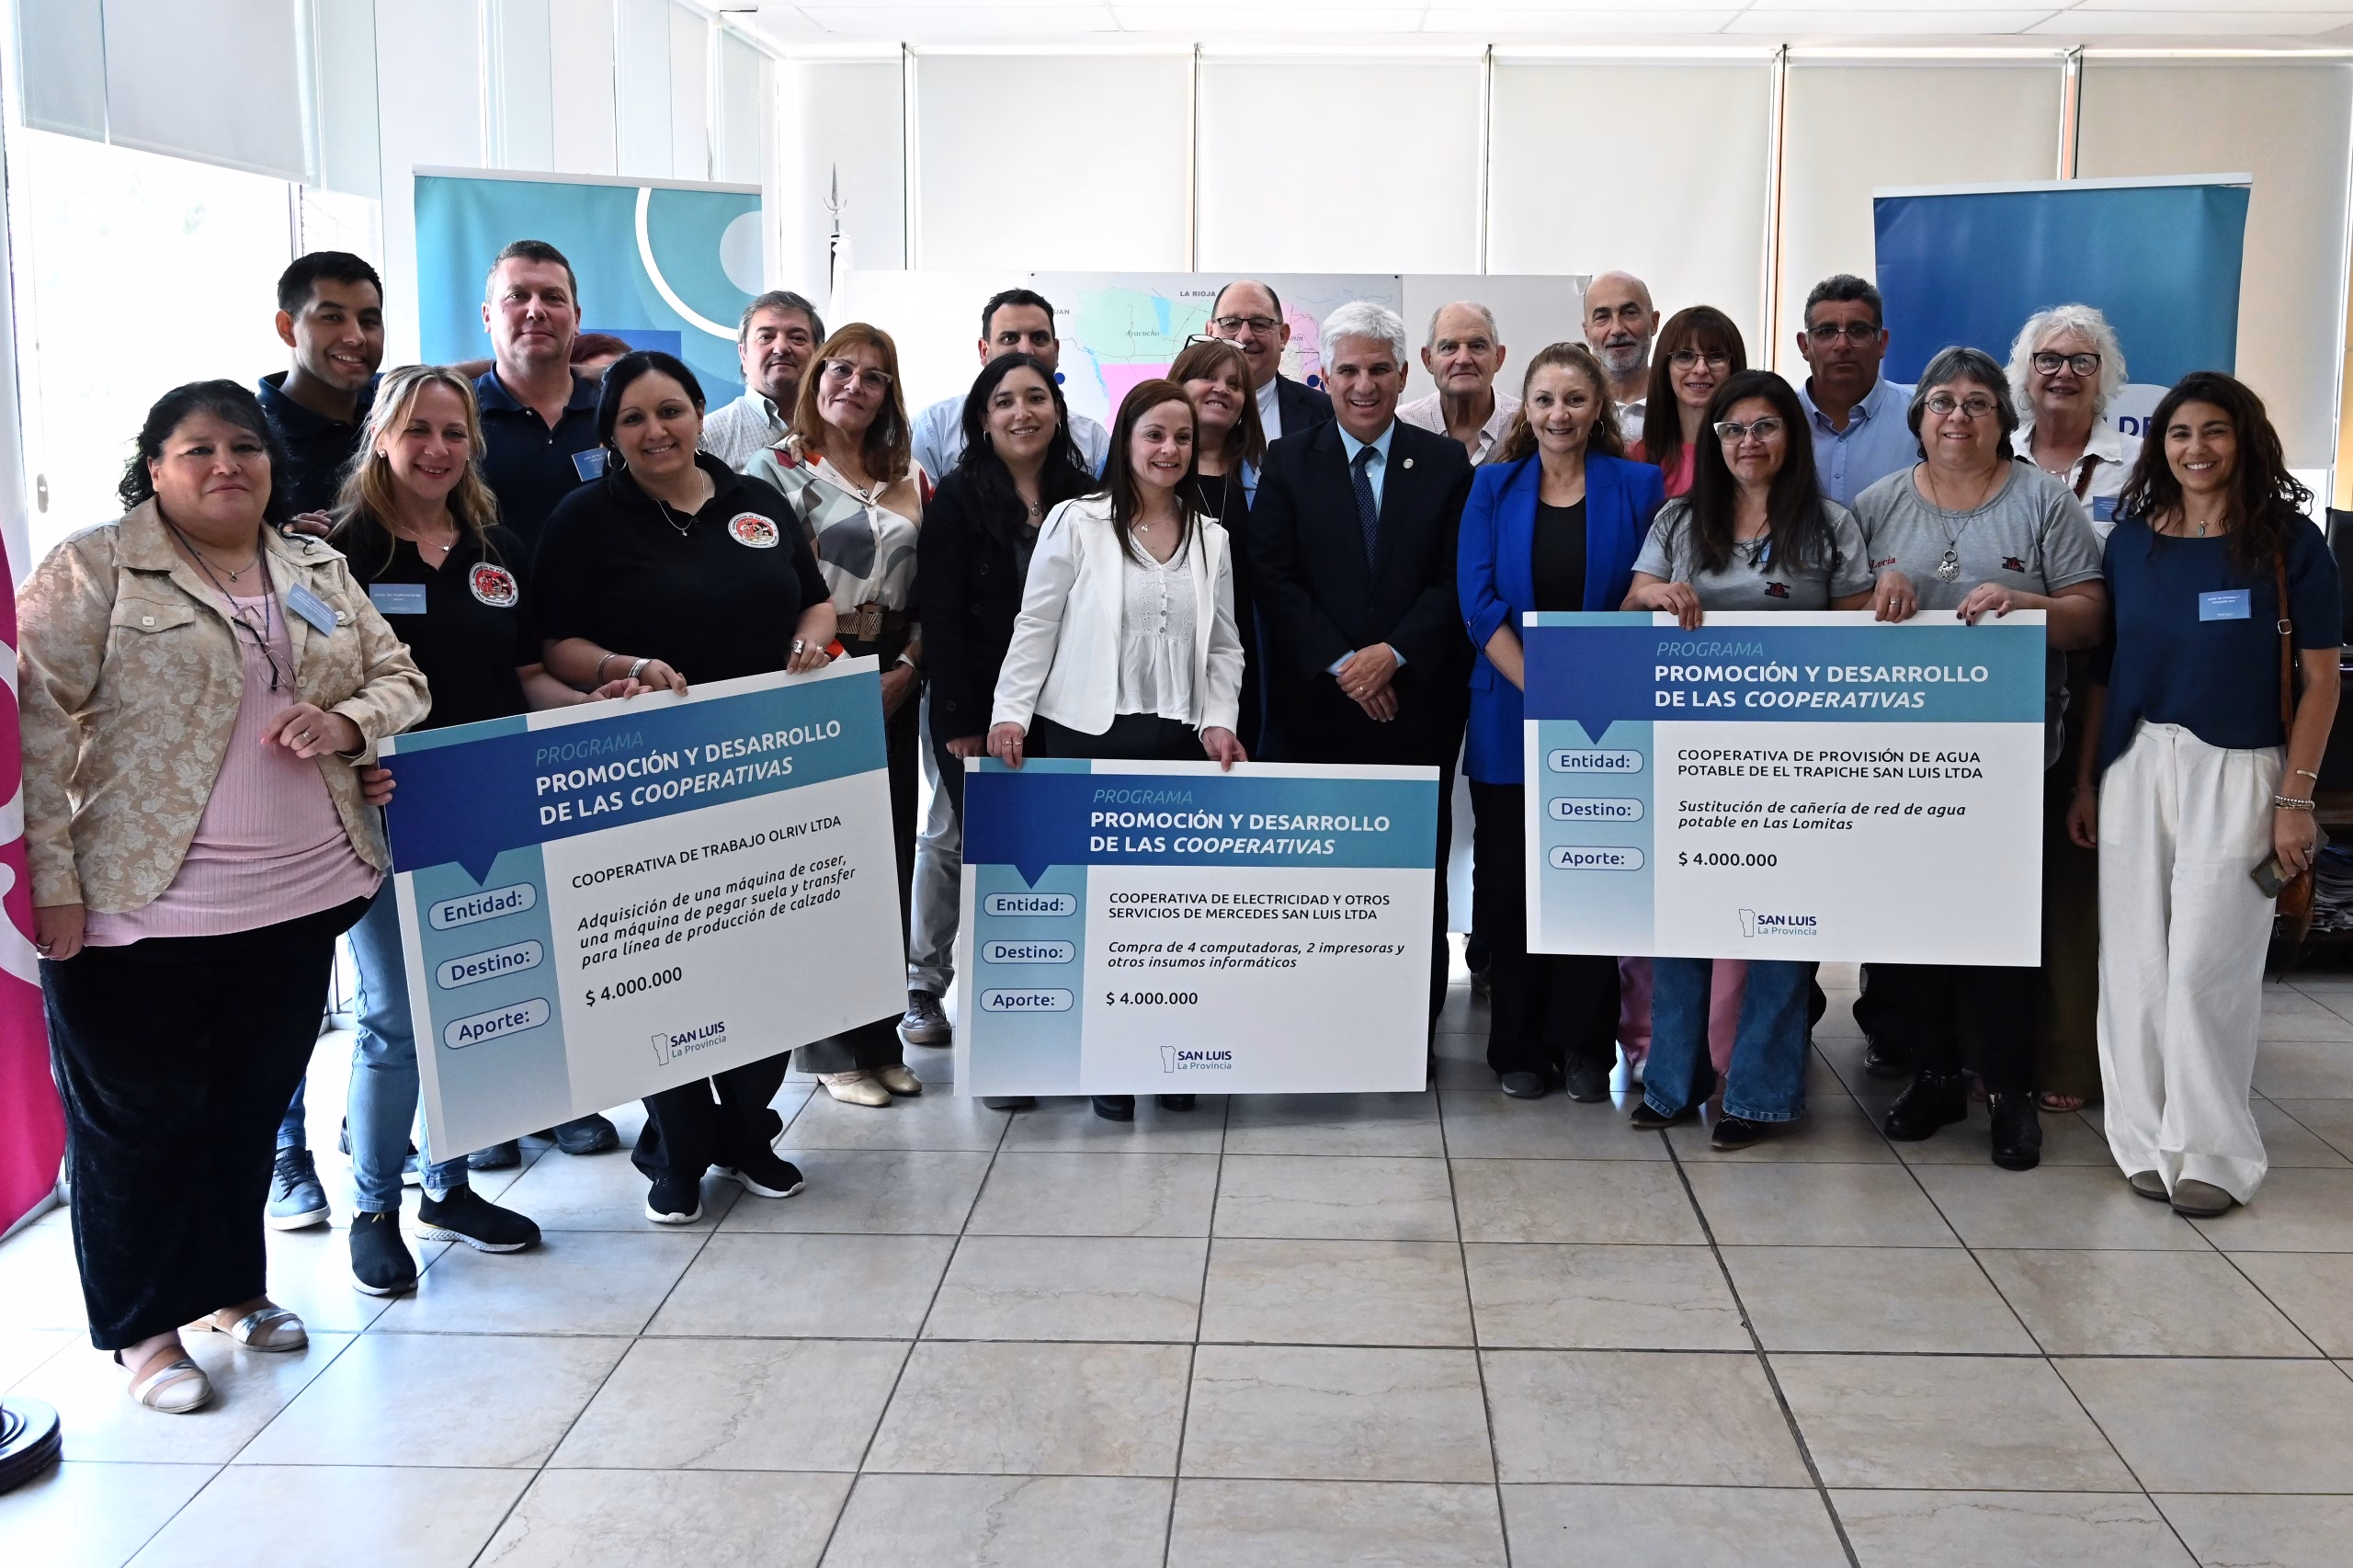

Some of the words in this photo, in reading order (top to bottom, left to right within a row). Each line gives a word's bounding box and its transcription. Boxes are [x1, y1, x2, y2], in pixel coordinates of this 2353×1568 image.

[1125, 329, 1160, 338] Ayacucho
[1656, 642, 1763, 657] PROGRAMA
[1654, 660, 1798, 683] PROMOCIÓN
[1804, 665, 1821, 682] Y
[1827, 665, 1988, 683] DESARROLLO
[1654, 690, 1686, 707] DE
[1692, 690, 1736, 708] LAS
[1745, 691, 1926, 709] COOPERATIVAS
[536, 731, 643, 767] PROGRAMA
[1677, 749, 1789, 762] COOPERATIVA
[1793, 751, 1814, 762] DE
[1819, 747, 1904, 763] PROVISIÓN
[1910, 752, 1930, 763] DE
[1935, 752, 1981, 763] AGUA
[536, 749, 679, 796] PROMOCIÓN
[683, 746, 699, 766] Y
[705, 720, 841, 763] DESARROLLO
[1561, 754, 1630, 768] Entidad:
[1678, 765, 1745, 777] POTABLE
[1749, 766, 1769, 777] DE
[1773, 766, 1790, 778] EL
[1793, 766, 1870, 778] TRAPICHE
[1872, 767, 1904, 778] SAN
[1908, 767, 1941, 778] LUIS
[1945, 767, 1984, 778] LTDA
[540, 801, 573, 825] DE
[578, 791, 623, 818] LAS
[631, 756, 793, 806] COOPERATIVAS
[1093, 789, 1192, 805] PROGRAMA
[1562, 802, 1631, 816] Destino:
[1677, 800, 1763, 813] Sustitución
[1768, 801, 1786, 813] de
[1790, 801, 1847, 814] cañería
[1850, 801, 1870, 814] de
[1873, 802, 1901, 815] red
[1904, 802, 1923, 815] de
[1927, 806, 1966, 818] agua
[1091, 809, 1223, 830] PROMOCIÓN
[1229, 813, 1244, 830] Y
[1249, 814, 1390, 832] DESARROLLO
[1677, 815, 1737, 830] potable
[1741, 819, 1758, 828] en
[1763, 817, 1789, 829] Las
[1792, 817, 1853, 830] Lomitas
[572, 854, 677, 889] COOPERATIVA
[679, 848, 699, 864] DE
[701, 833, 766, 858] TRABAJO
[768, 823, 808, 842] OLRIV
[811, 815, 842, 833] LTDA
[1090, 835, 1119, 852] DE
[1125, 836, 1166, 853] LAS
[1173, 836, 1336, 855] COOPERATIVAS
[1561, 851, 1625, 867] Aporte:
[1678, 851, 1688, 867] $
[1692, 852, 1778, 868] 4.000.000
[577, 898, 667, 932] Adquisición
[672, 892, 690, 907] de
[694, 886, 721, 902] una
[725, 869, 785, 894] máquina
[790, 863, 806, 878] de
[809, 855, 847, 872] coser,
[1109, 892, 1208, 904] COOPERATIVA
[1211, 893, 1230, 904] DE
[1233, 893, 1330, 905] ELECTRICIDAD
[1333, 894, 1342, 905] Y
[1345, 894, 1390, 905] OTROS
[444, 891, 523, 923] Entidad:
[580, 932, 608, 949] una
[614, 915, 679, 940] máquina
[684, 906, 701, 922] de
[706, 896, 747, 920] pegar
[751, 884, 788, 905] suela
[790, 883, 799, 898] y
[802, 868, 856, 892] transfer
[996, 898, 1063, 912] Entidad:
[1108, 907, 1180, 919] SERVICIOS
[1184, 908, 1202, 919] DE
[1205, 908, 1279, 920] MERCEDES
[1281, 909, 1309, 920] SAN
[1313, 909, 1341, 920] LUIS
[1345, 909, 1378, 920] LTDA
[1757, 915, 1785, 926] SAN
[1788, 915, 1817, 926] LUIS
[582, 948, 618, 971] para
[622, 937, 660, 956] línea
[665, 929, 683, 945] de
[687, 908, 766, 942] producción
[769, 902, 786, 916] de
[790, 887, 841, 911] calzado
[1757, 926, 1768, 935] La
[1771, 926, 1817, 936] Provincia
[995, 945, 1063, 959] Destino:
[1108, 941, 1163, 955] Compra
[1166, 940, 1184, 953] de
[1187, 942, 1197, 953] 4
[1199, 941, 1302, 956] computadoras,
[1306, 942, 1315, 953] 2
[1318, 942, 1394, 956] impresoras
[1394, 945, 1405, 956] y
[451, 951, 530, 982] Destino:
[1108, 957, 1145, 968] otros
[1148, 956, 1206, 968] insumos
[1209, 956, 1297, 970] informáticos
[585, 989, 596, 1007] $
[600, 966, 682, 1001] 4.000.000
[992, 994, 1055, 1009] Aporte:
[1106, 991, 1115, 1006] $
[1120, 992, 1199, 1005] 4.000.000
[459, 1011, 530, 1041] Aporte:
[670, 1029, 697, 1048] SAN
[699, 1021, 725, 1040] LUIS
[671, 1049, 683, 1059] La
[684, 1034, 727, 1054] Provincia
[1177, 1051, 1203, 1061] SAN
[1206, 1051, 1233, 1061] LUIS
[1177, 1062, 1188, 1070] La
[1189, 1061, 1232, 1070] Provincia
